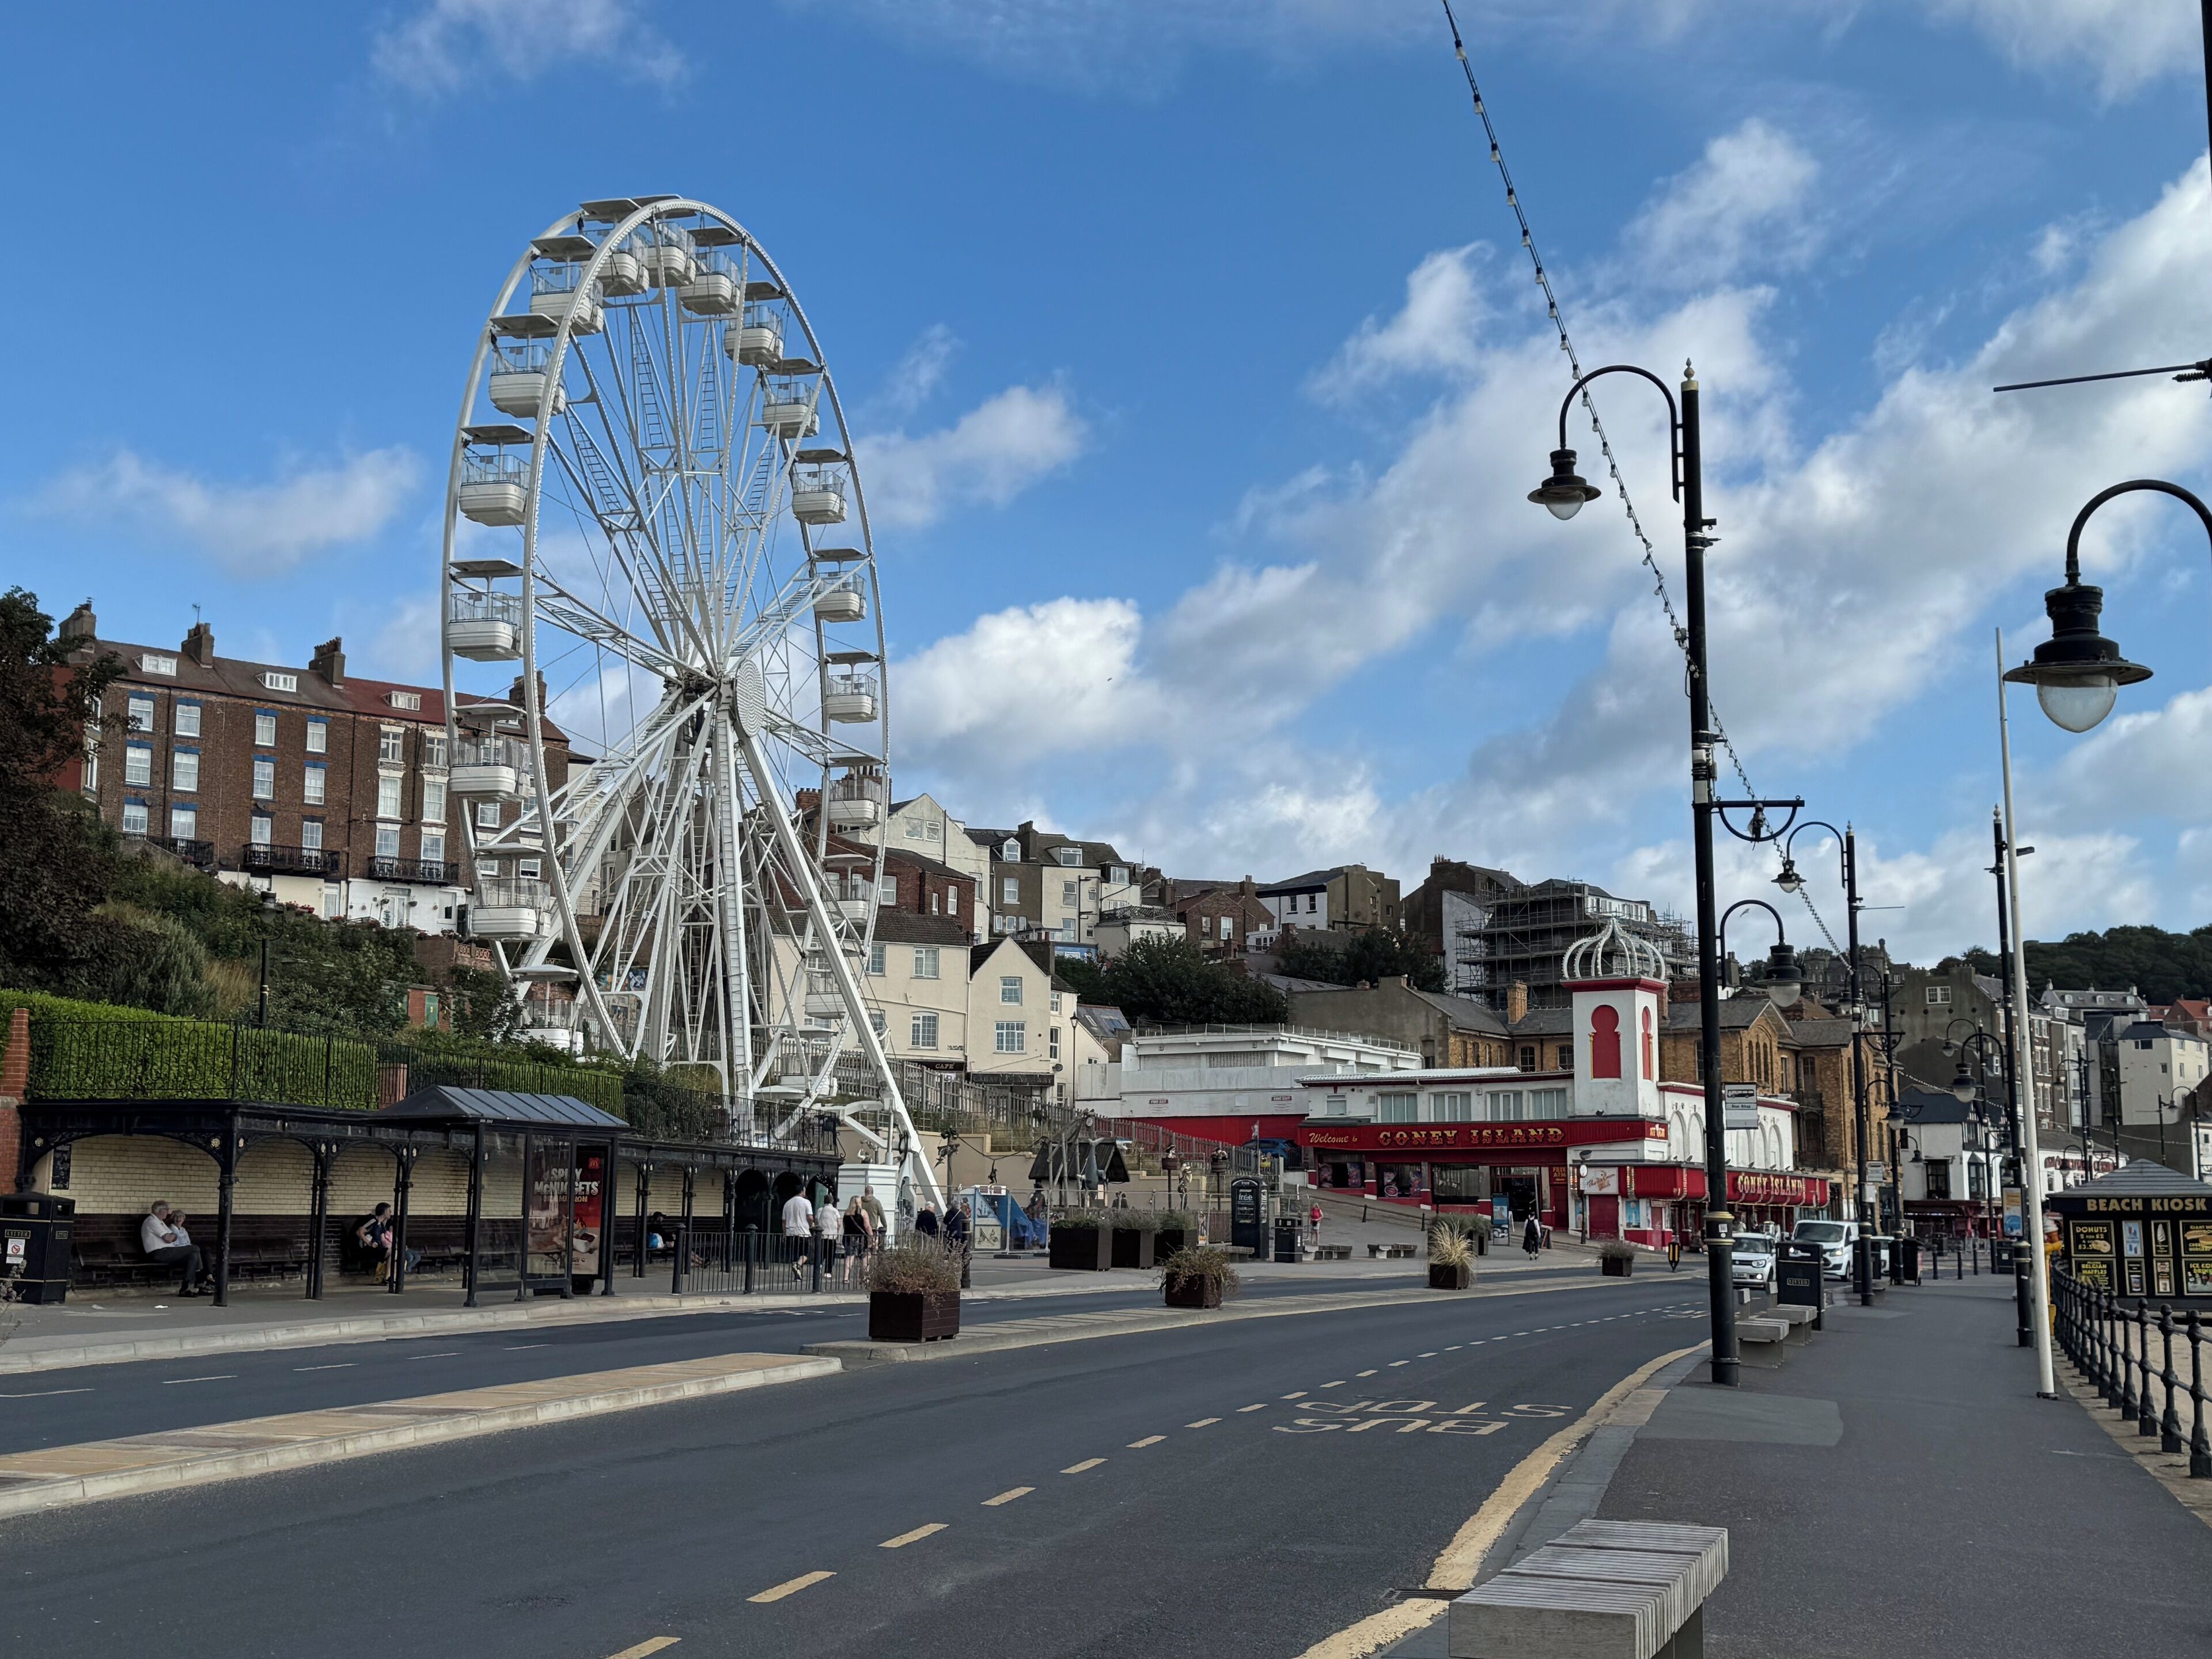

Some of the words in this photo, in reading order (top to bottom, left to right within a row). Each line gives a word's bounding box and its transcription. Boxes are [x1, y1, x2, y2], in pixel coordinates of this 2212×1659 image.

[1309, 1132, 1349, 1143] Welcome
[1377, 1130, 1457, 1146] CONEY
[1469, 1127, 1565, 1144] ISLAND
[551, 1168, 582, 1181] SPIY
[1738, 1175, 1767, 1194] CONEY
[1770, 1176, 1802, 1196] ISLAND
[2086, 1199, 2143, 1211] BEACH
[2152, 1198, 2207, 1211] KIOSK
[1295, 1400, 1573, 1418] STOP
[1271, 1418, 1510, 1435] BUS
